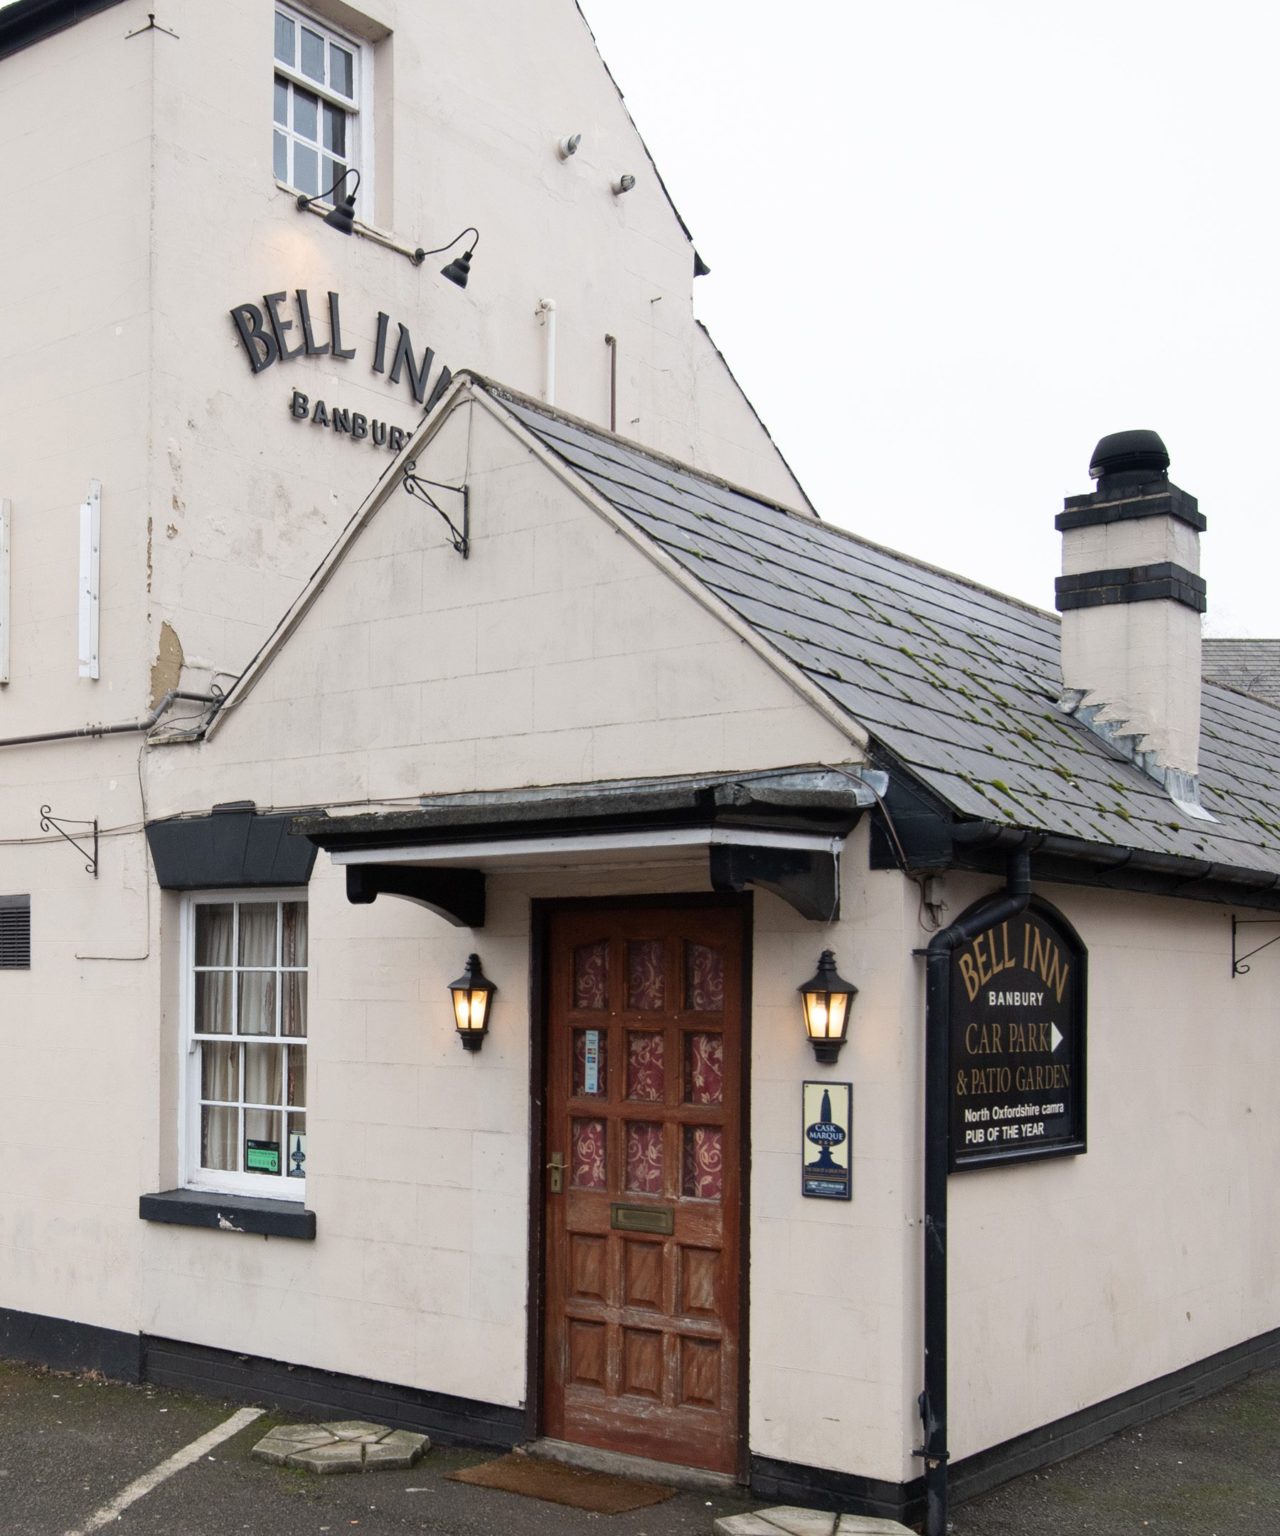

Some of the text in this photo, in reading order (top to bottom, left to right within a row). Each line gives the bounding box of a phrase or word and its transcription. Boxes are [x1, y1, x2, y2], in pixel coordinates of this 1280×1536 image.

[230, 289, 356, 374] BELL
[290, 391, 413, 451] BANBUR
[958, 920, 1069, 1003] BELL INN
[989, 991, 1044, 1006] BANBURY
[965, 1023, 1049, 1055] CAR PARK
[956, 1064, 1070, 1096] & PATIO GARDEN
[965, 1103, 1064, 1123] North Oxfordshire camra
[809, 1132, 844, 1140] MARQUE
[815, 1124, 836, 1132] CASK
[966, 1122, 1045, 1144] PUB OF THE YEAR
